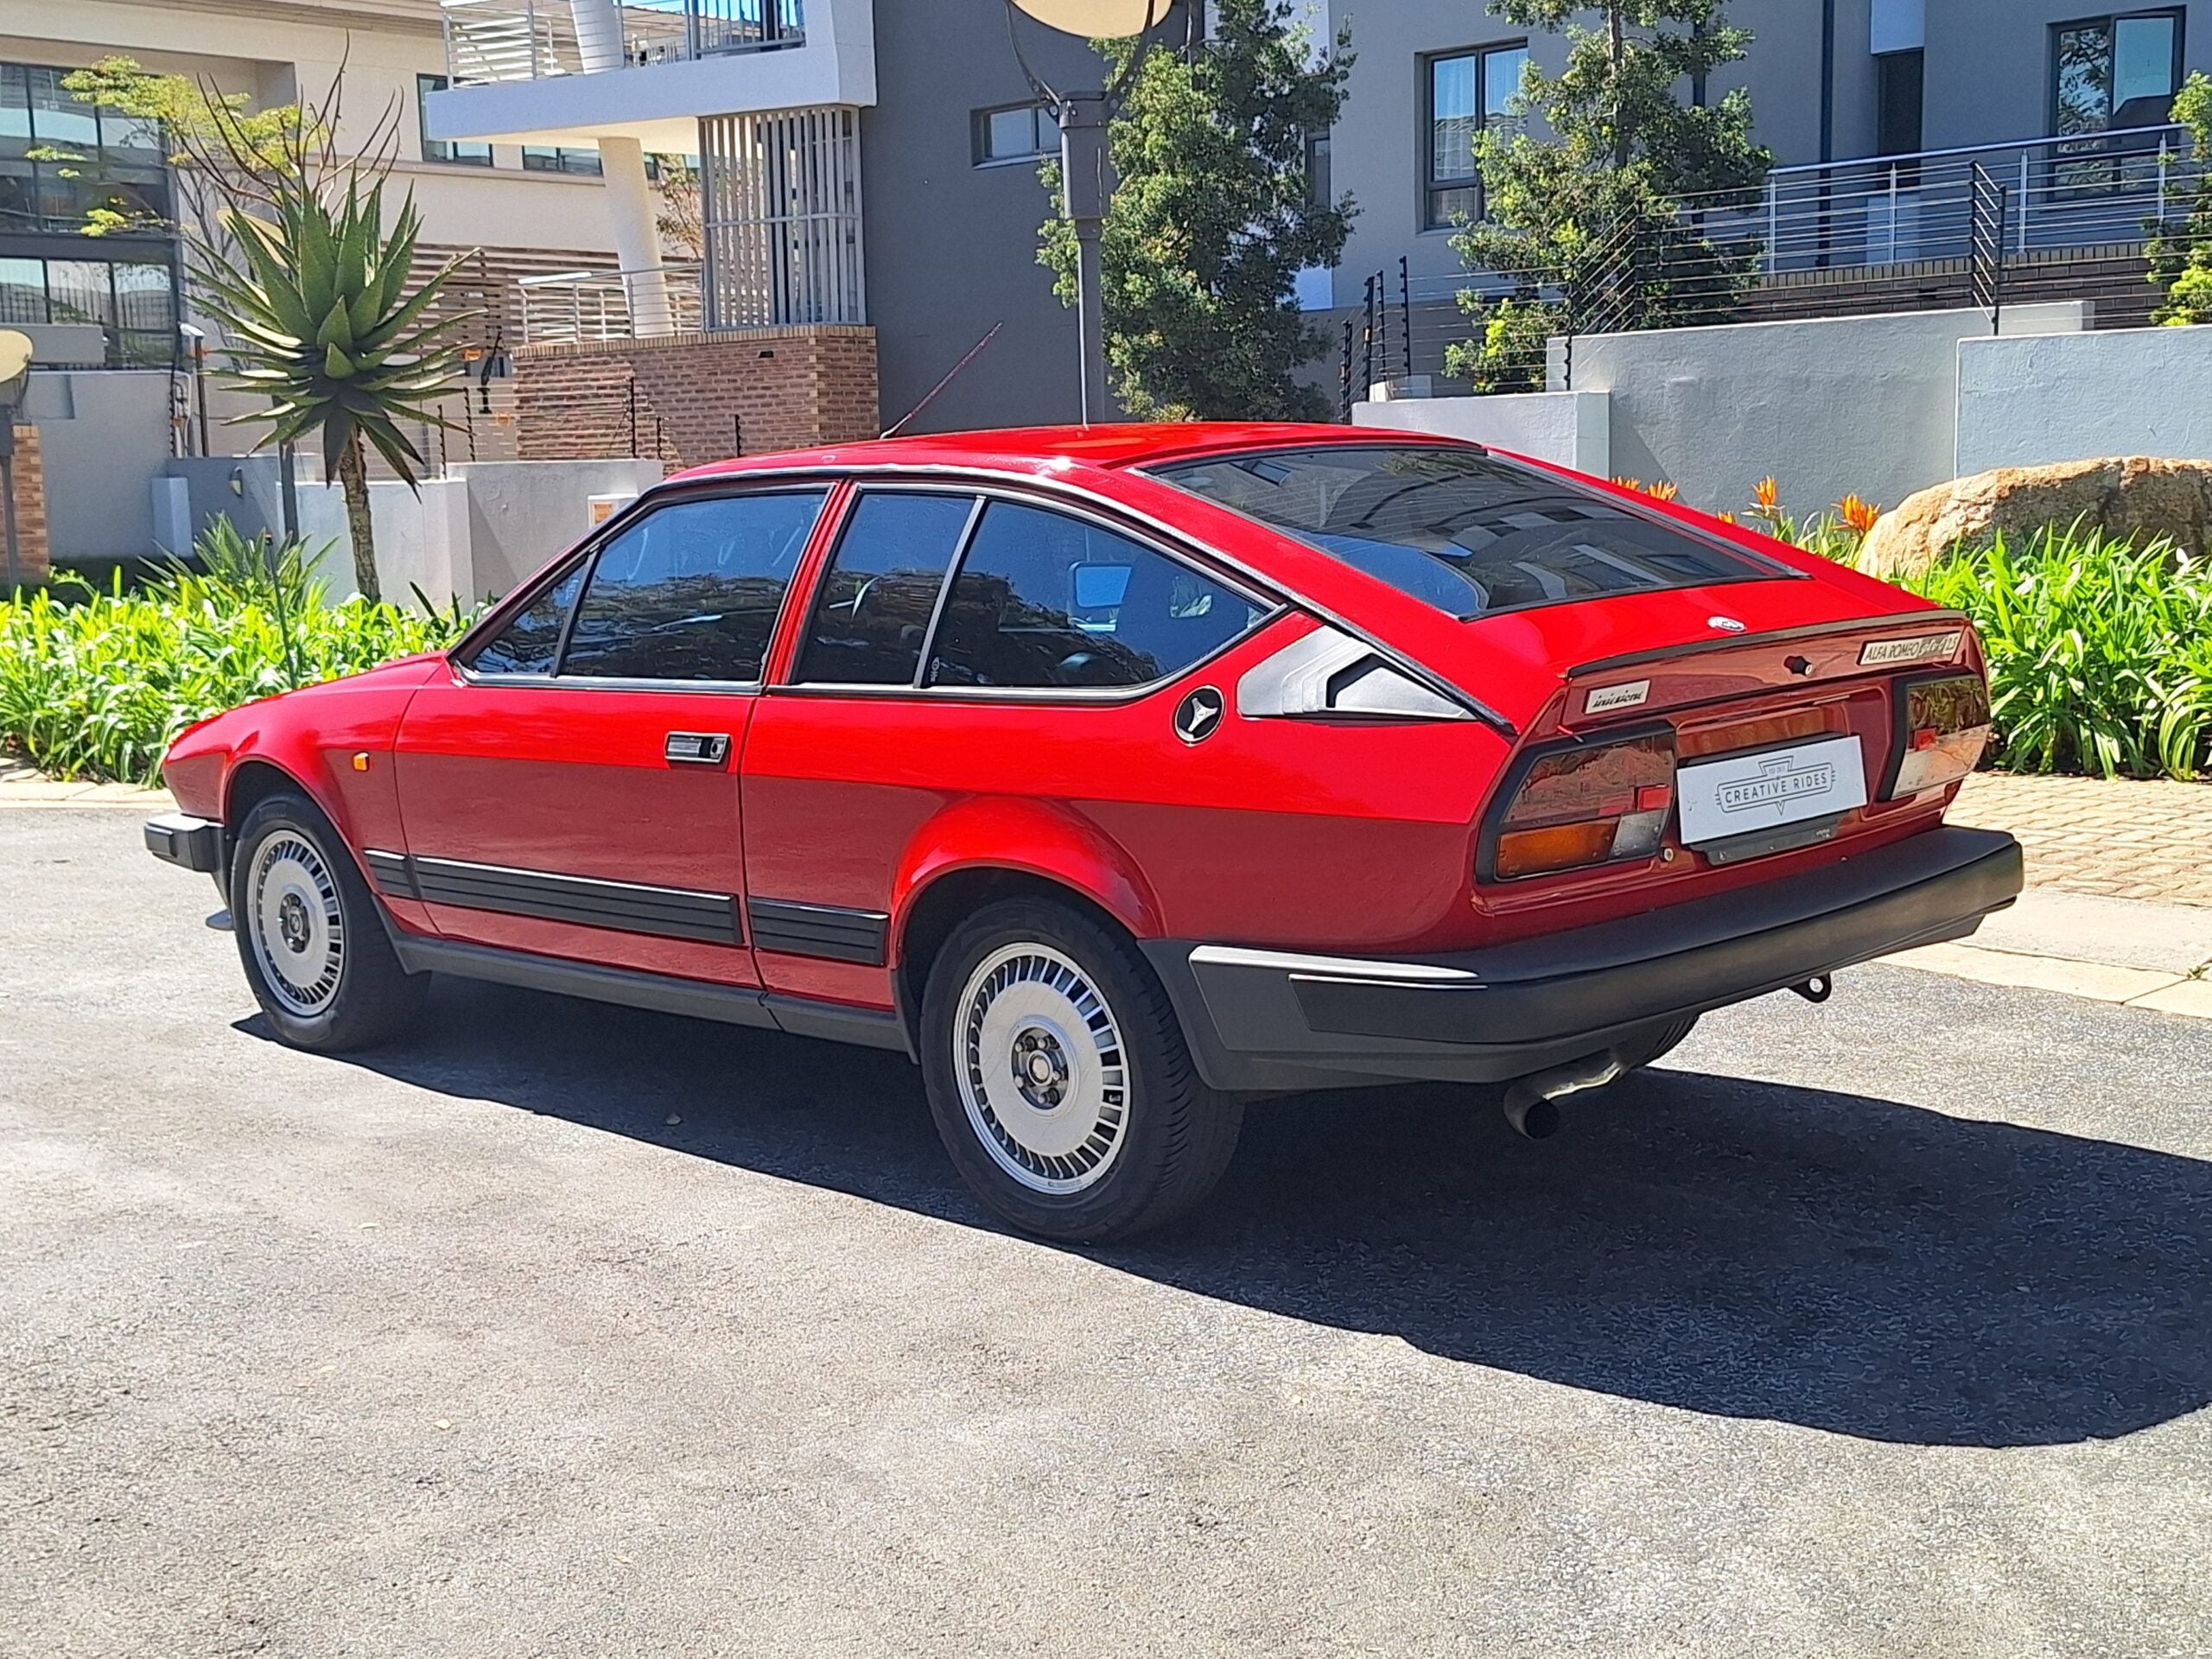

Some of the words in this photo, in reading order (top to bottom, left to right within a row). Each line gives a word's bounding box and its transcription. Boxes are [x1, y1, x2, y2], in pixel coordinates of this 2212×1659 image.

[1865, 645, 1887, 661] ALFA
[1889, 641, 1919, 658] ROMEO
[1725, 780, 1787, 804] CREATIVE
[1793, 772, 1827, 790] RIDES
